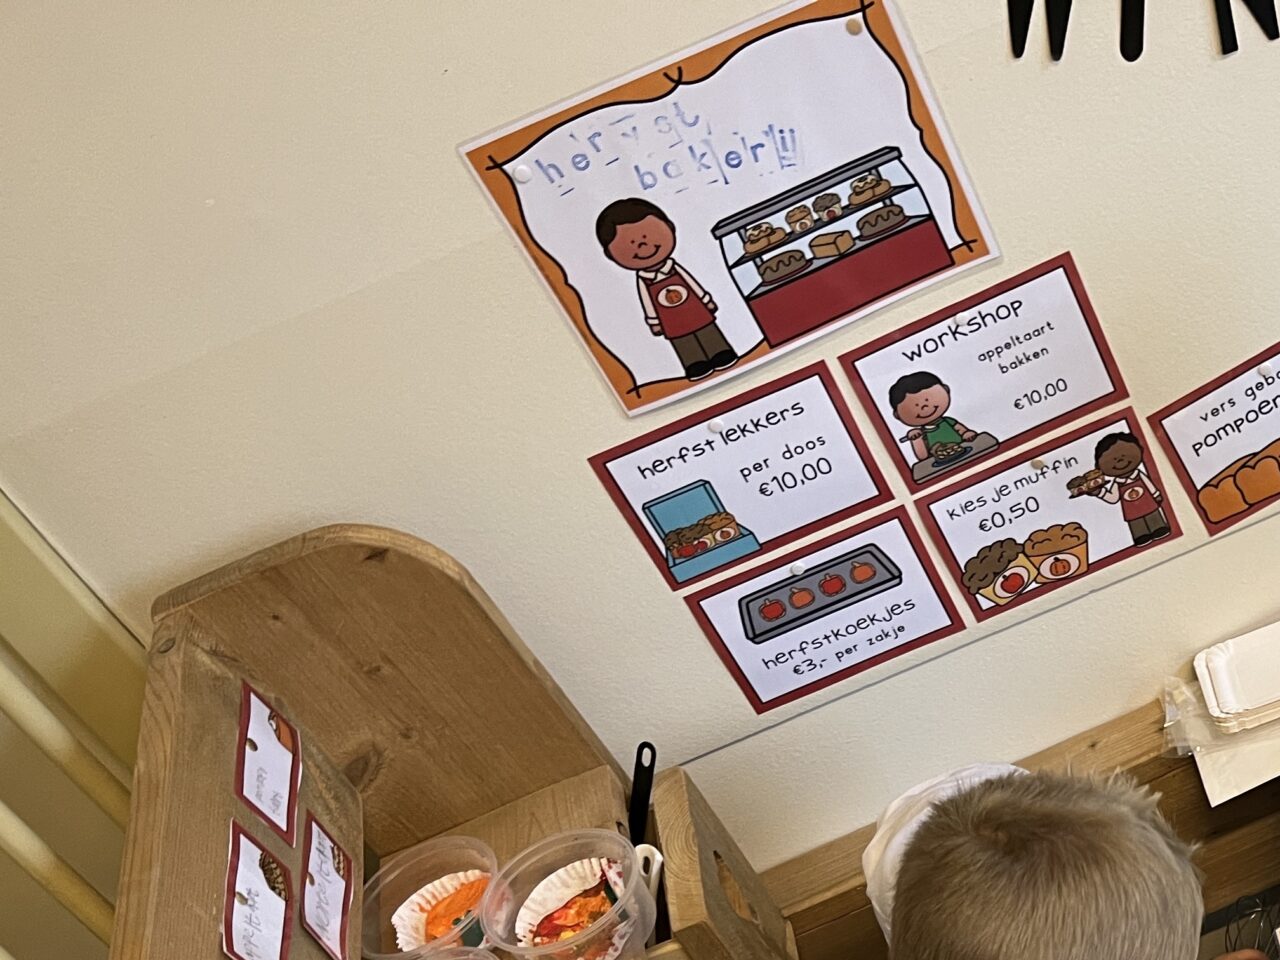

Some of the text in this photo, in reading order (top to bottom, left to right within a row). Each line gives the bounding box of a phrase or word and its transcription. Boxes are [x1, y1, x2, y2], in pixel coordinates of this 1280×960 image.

[902, 299, 1023, 361] workshop
[977, 321, 1055, 363] appeltaart
[998, 347, 1049, 374] bakken
[1013, 378, 1068, 410] €10,00
[1200, 397, 1236, 421] vers
[740, 435, 826, 483] per doos
[759, 457, 832, 497] €10,00
[946, 456, 1079, 521] kies je muffin
[979, 496, 1040, 532] €0,50
[762, 598, 916, 670] herfstkoekjes
[835, 644, 859, 662] per
[867, 625, 905, 646] zakje
